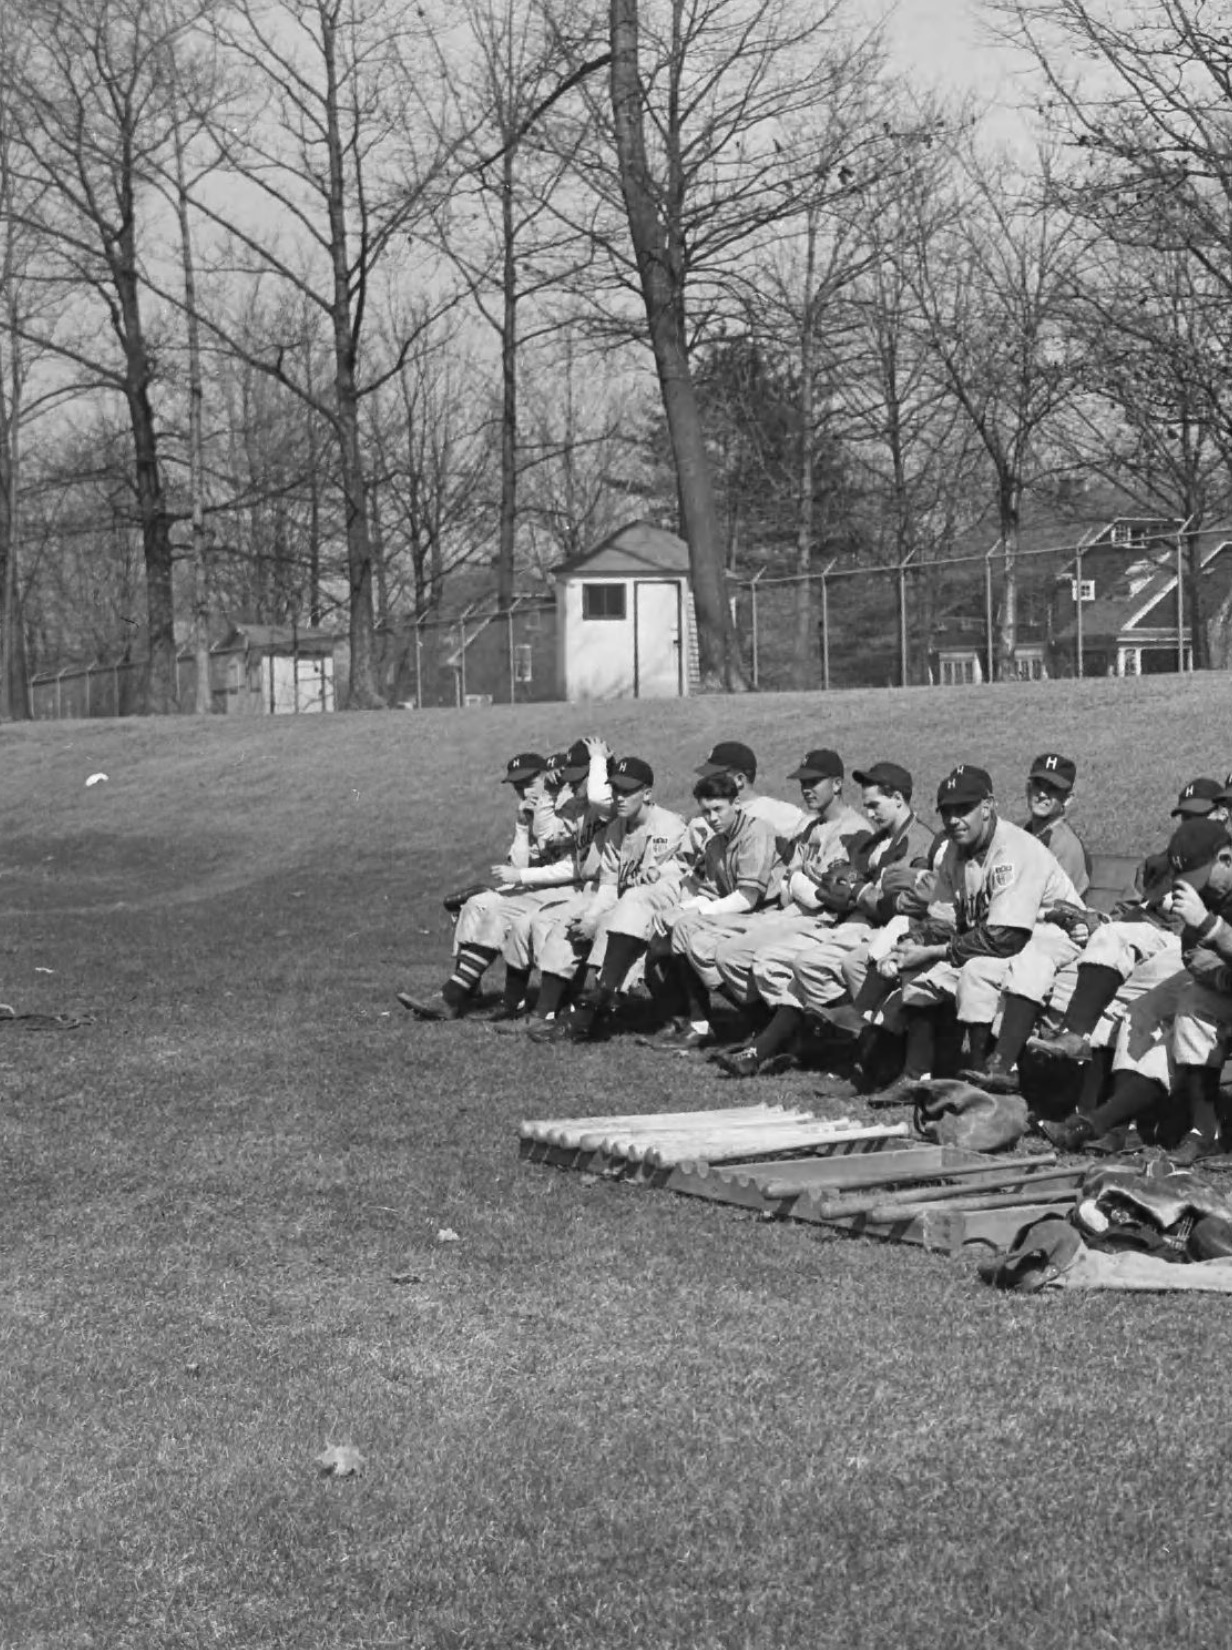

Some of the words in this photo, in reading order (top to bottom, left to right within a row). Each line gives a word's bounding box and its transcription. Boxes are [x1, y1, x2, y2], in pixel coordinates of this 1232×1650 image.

[512, 758, 520, 768] H
[546, 757, 555, 768] H
[619, 762, 627, 773] H
[1046, 757, 1058, 770] H
[948, 778, 956, 789] H
[1186, 785, 1194, 797] H
